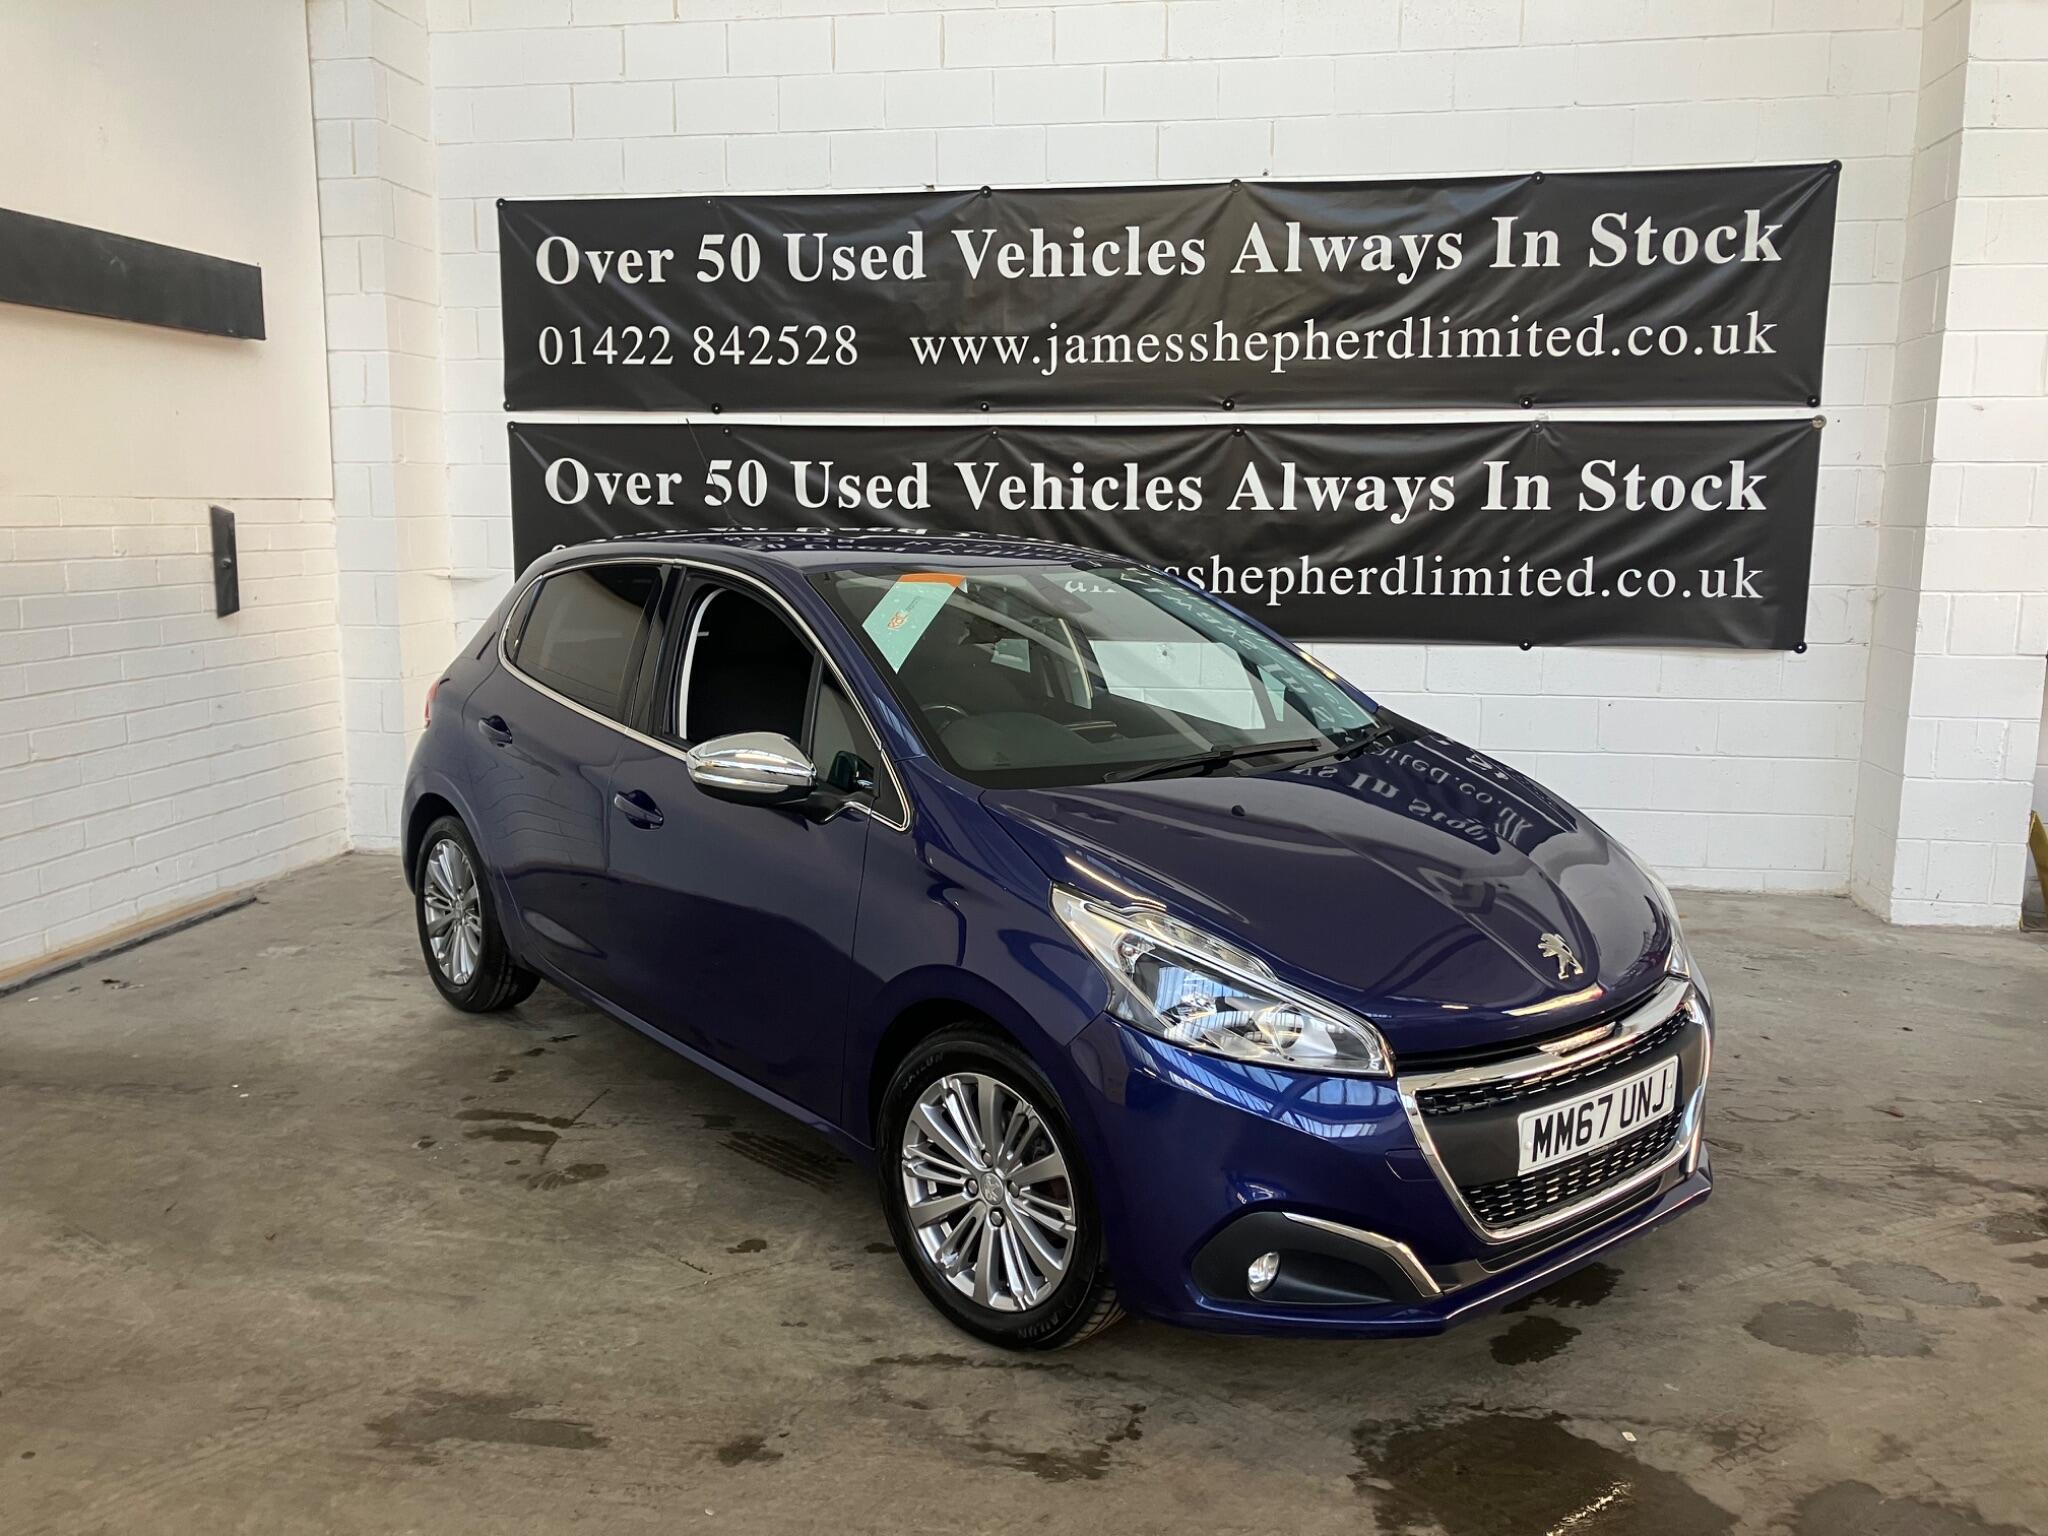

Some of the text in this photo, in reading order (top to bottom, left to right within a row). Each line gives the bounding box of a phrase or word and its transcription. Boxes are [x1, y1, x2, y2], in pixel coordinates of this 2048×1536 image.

[536, 209, 1783, 285] Over 50 Used Vehicles Always In Stock
[539, 310, 1777, 376] 01422 842528 www.jamesshepherdlimited.co.uk
[545, 457, 1767, 525] Over 50 Used Vehicles Always In Stock
[1531, 1068, 1669, 1162] MM67 UNJ
